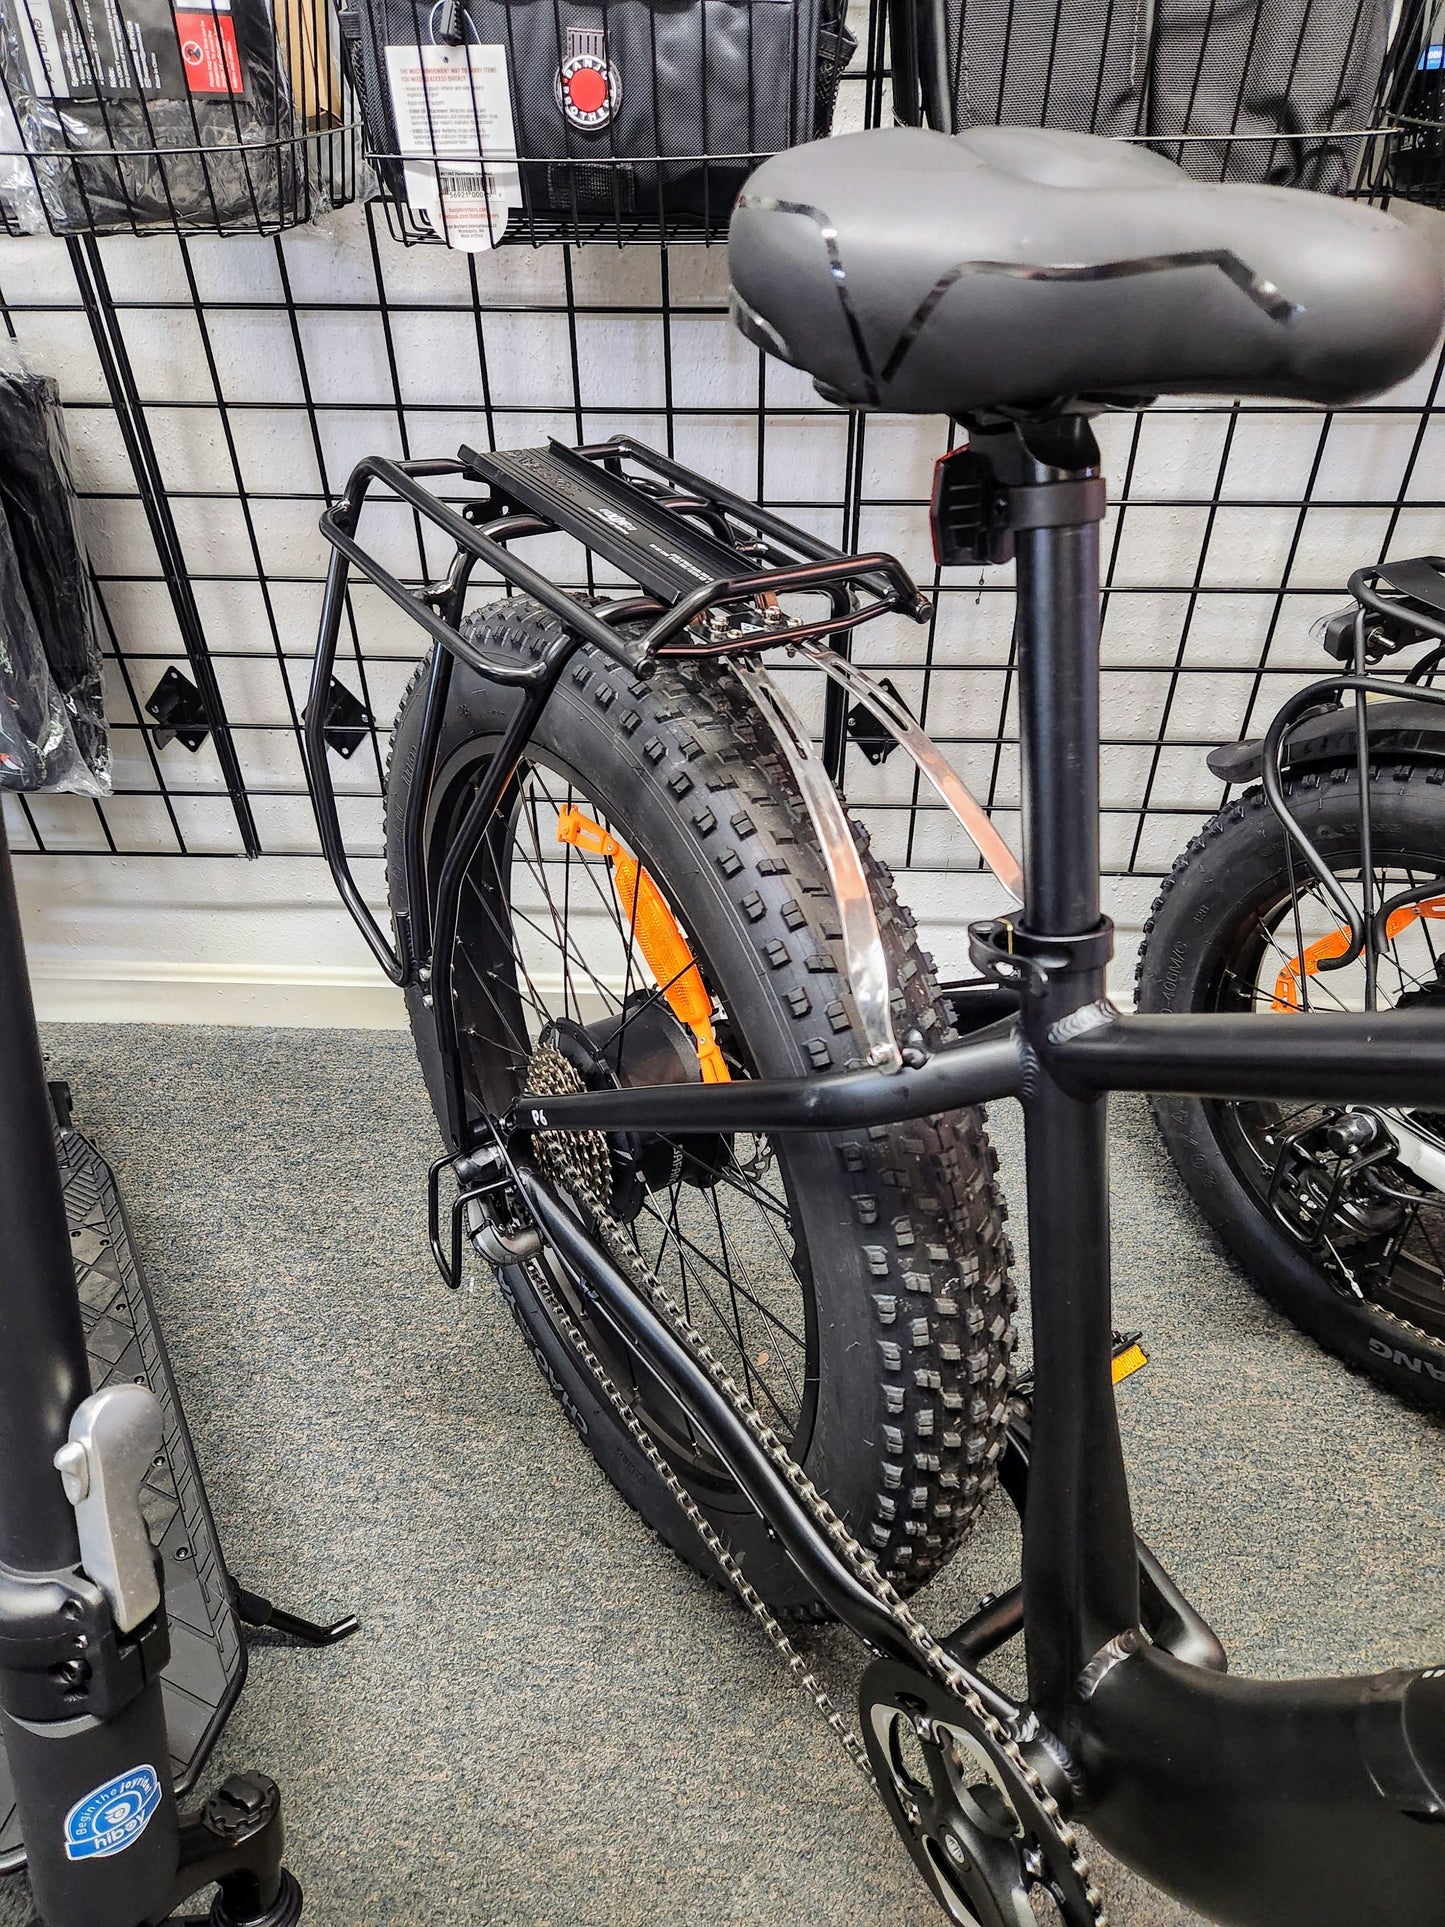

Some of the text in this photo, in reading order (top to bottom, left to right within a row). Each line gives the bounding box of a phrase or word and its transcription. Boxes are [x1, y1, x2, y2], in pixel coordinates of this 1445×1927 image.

[531, 1109, 548, 1126] P6
[75, 1806, 96, 1836] Begin
[95, 1788, 118, 1805] the
[94, 1808, 146, 1850] hiboy
